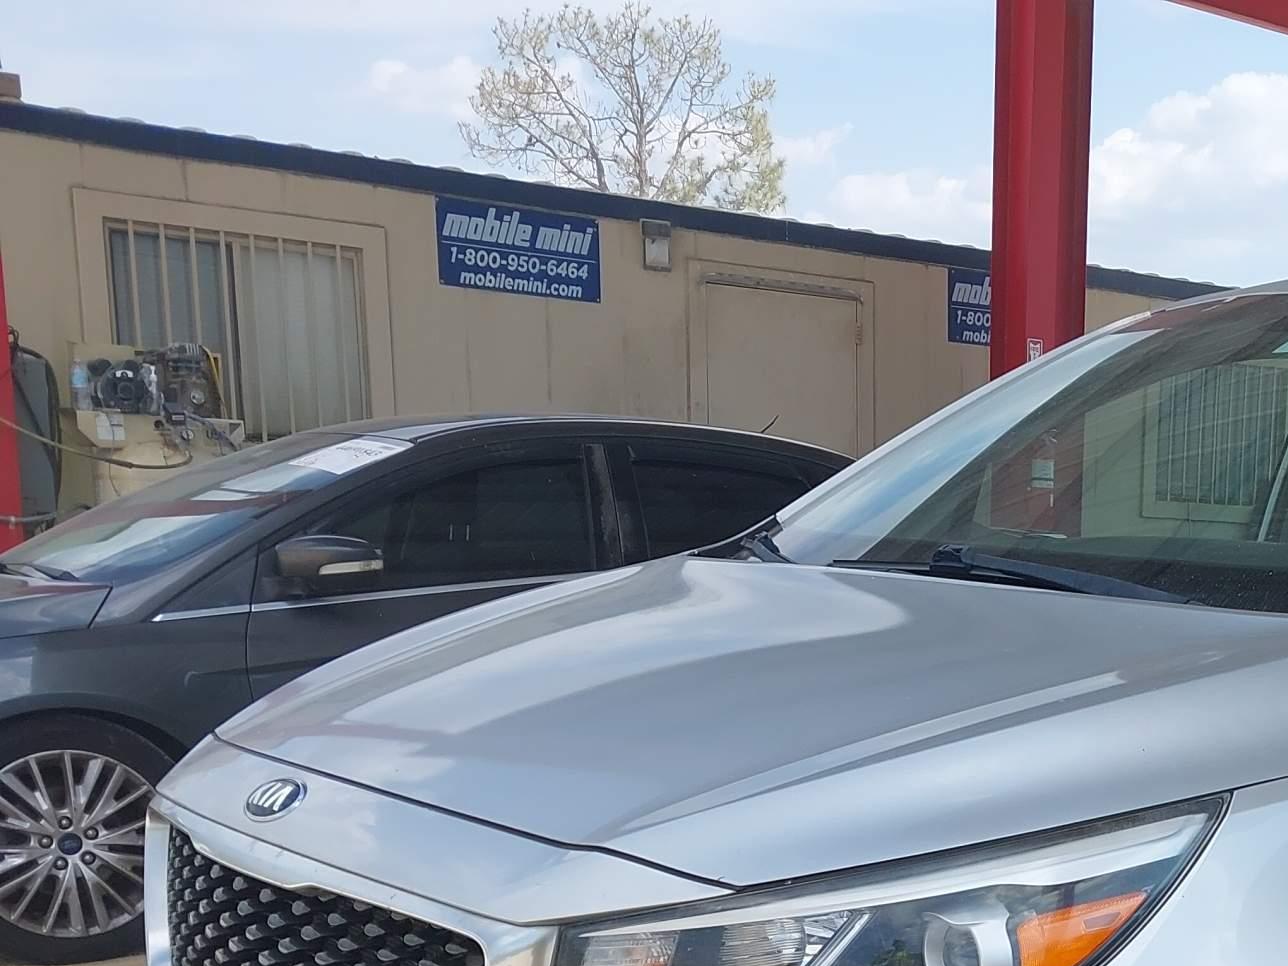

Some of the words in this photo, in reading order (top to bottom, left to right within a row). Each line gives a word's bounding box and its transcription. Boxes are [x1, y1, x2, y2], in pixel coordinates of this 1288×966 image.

[442, 207, 532, 247] mobile
[535, 223, 593, 256] mini
[450, 246, 589, 281] 1-800-950-6464
[459, 270, 583, 298] mobilemini.com
[248, 781, 294, 812] KIA
